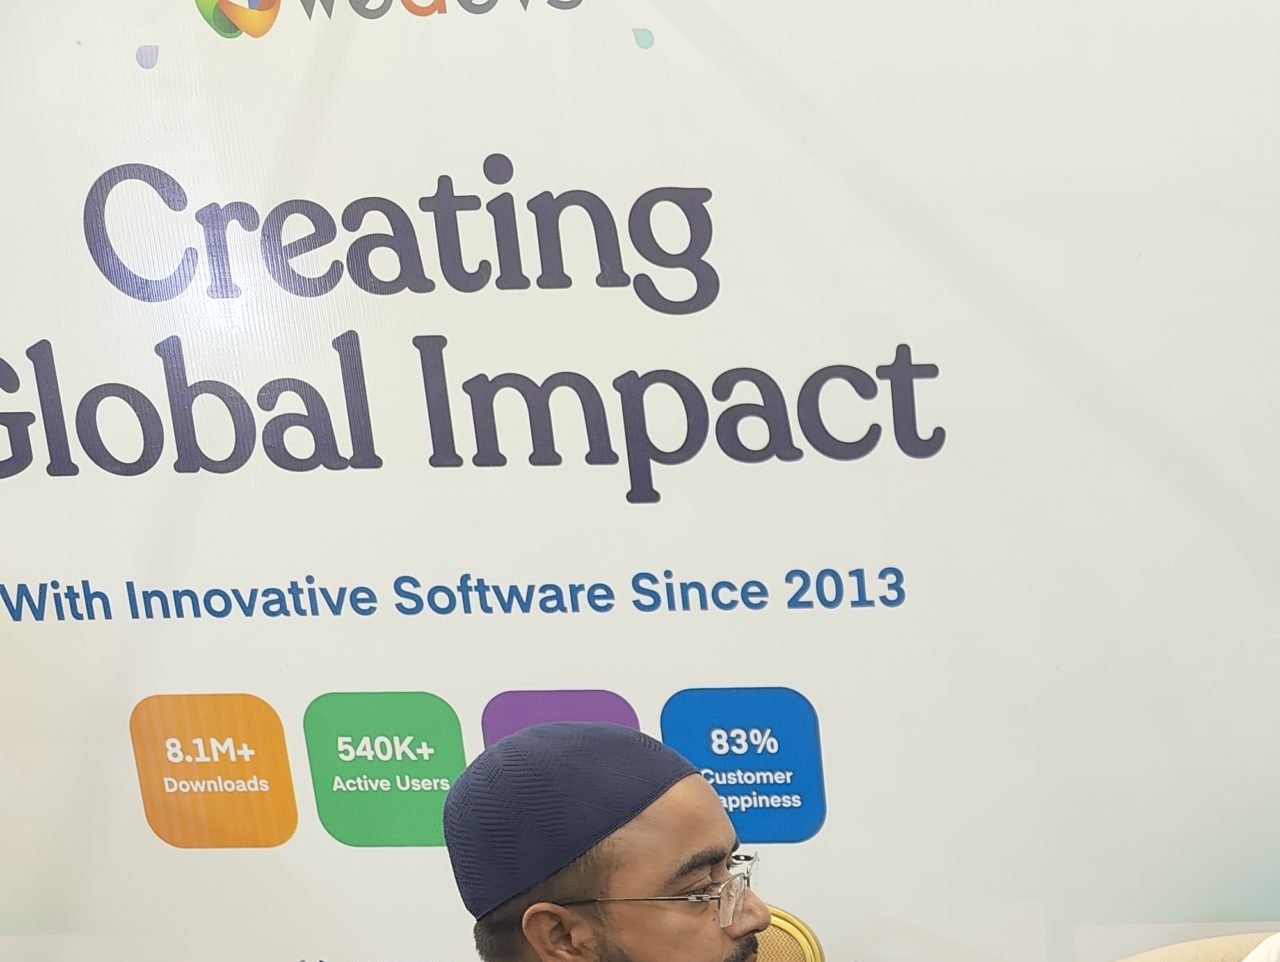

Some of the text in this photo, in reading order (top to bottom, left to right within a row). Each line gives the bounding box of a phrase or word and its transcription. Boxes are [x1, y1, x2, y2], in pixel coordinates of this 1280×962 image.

[83, 152, 721, 316] Creating
[412, 334, 947, 505] Impact
[0, 566, 906, 623] With Innovative Software Since 2013
[165, 737, 256, 763] 8.1M+
[337, 735, 436, 762] 540K+
[711, 727, 779, 755] 83%
[163, 775, 270, 793] Downloads
[332, 774, 451, 792] Active Users
[700, 768, 794, 785] Customer
[719, 791, 802, 812] appiness
